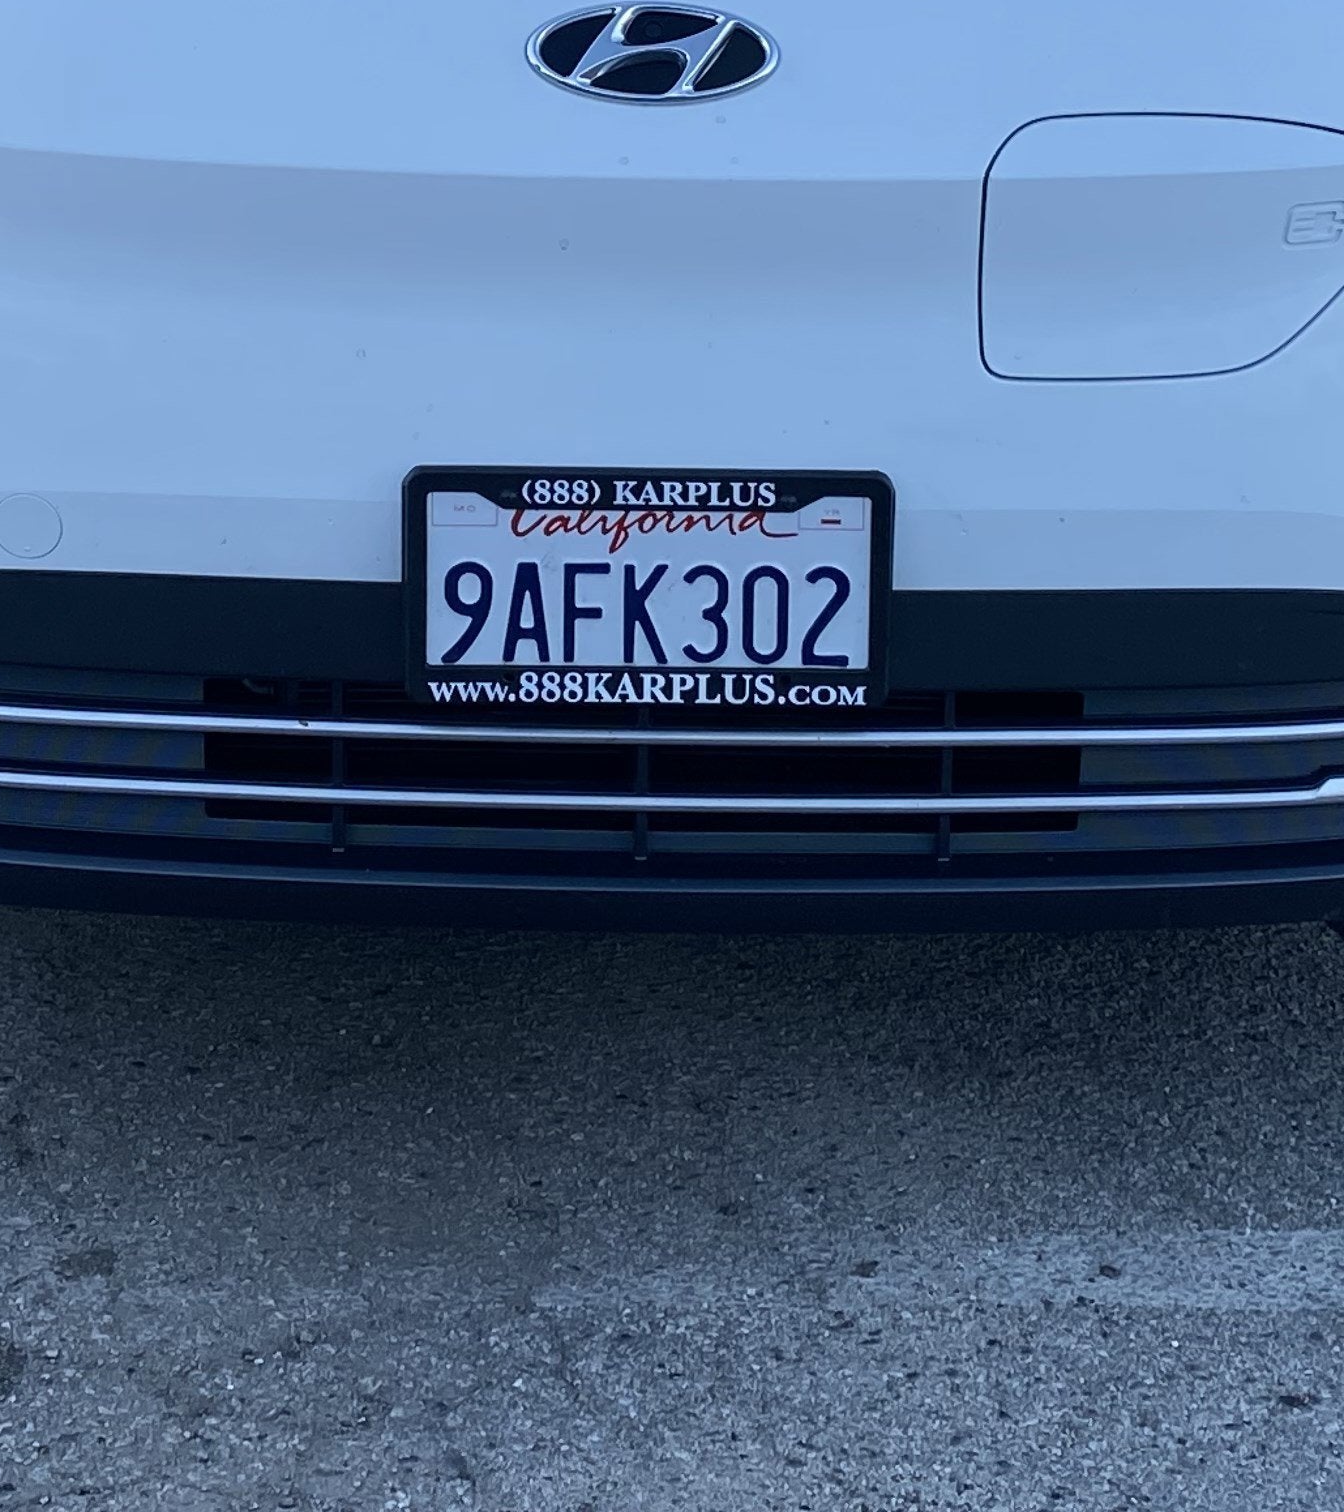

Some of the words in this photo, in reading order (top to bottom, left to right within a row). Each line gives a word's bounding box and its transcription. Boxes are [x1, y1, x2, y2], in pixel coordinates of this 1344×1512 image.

[522, 479, 601, 506] (888)
[612, 481, 777, 507] KARPLUS
[511, 507, 799, 553] California
[441, 561, 851, 667] 9AFK302
